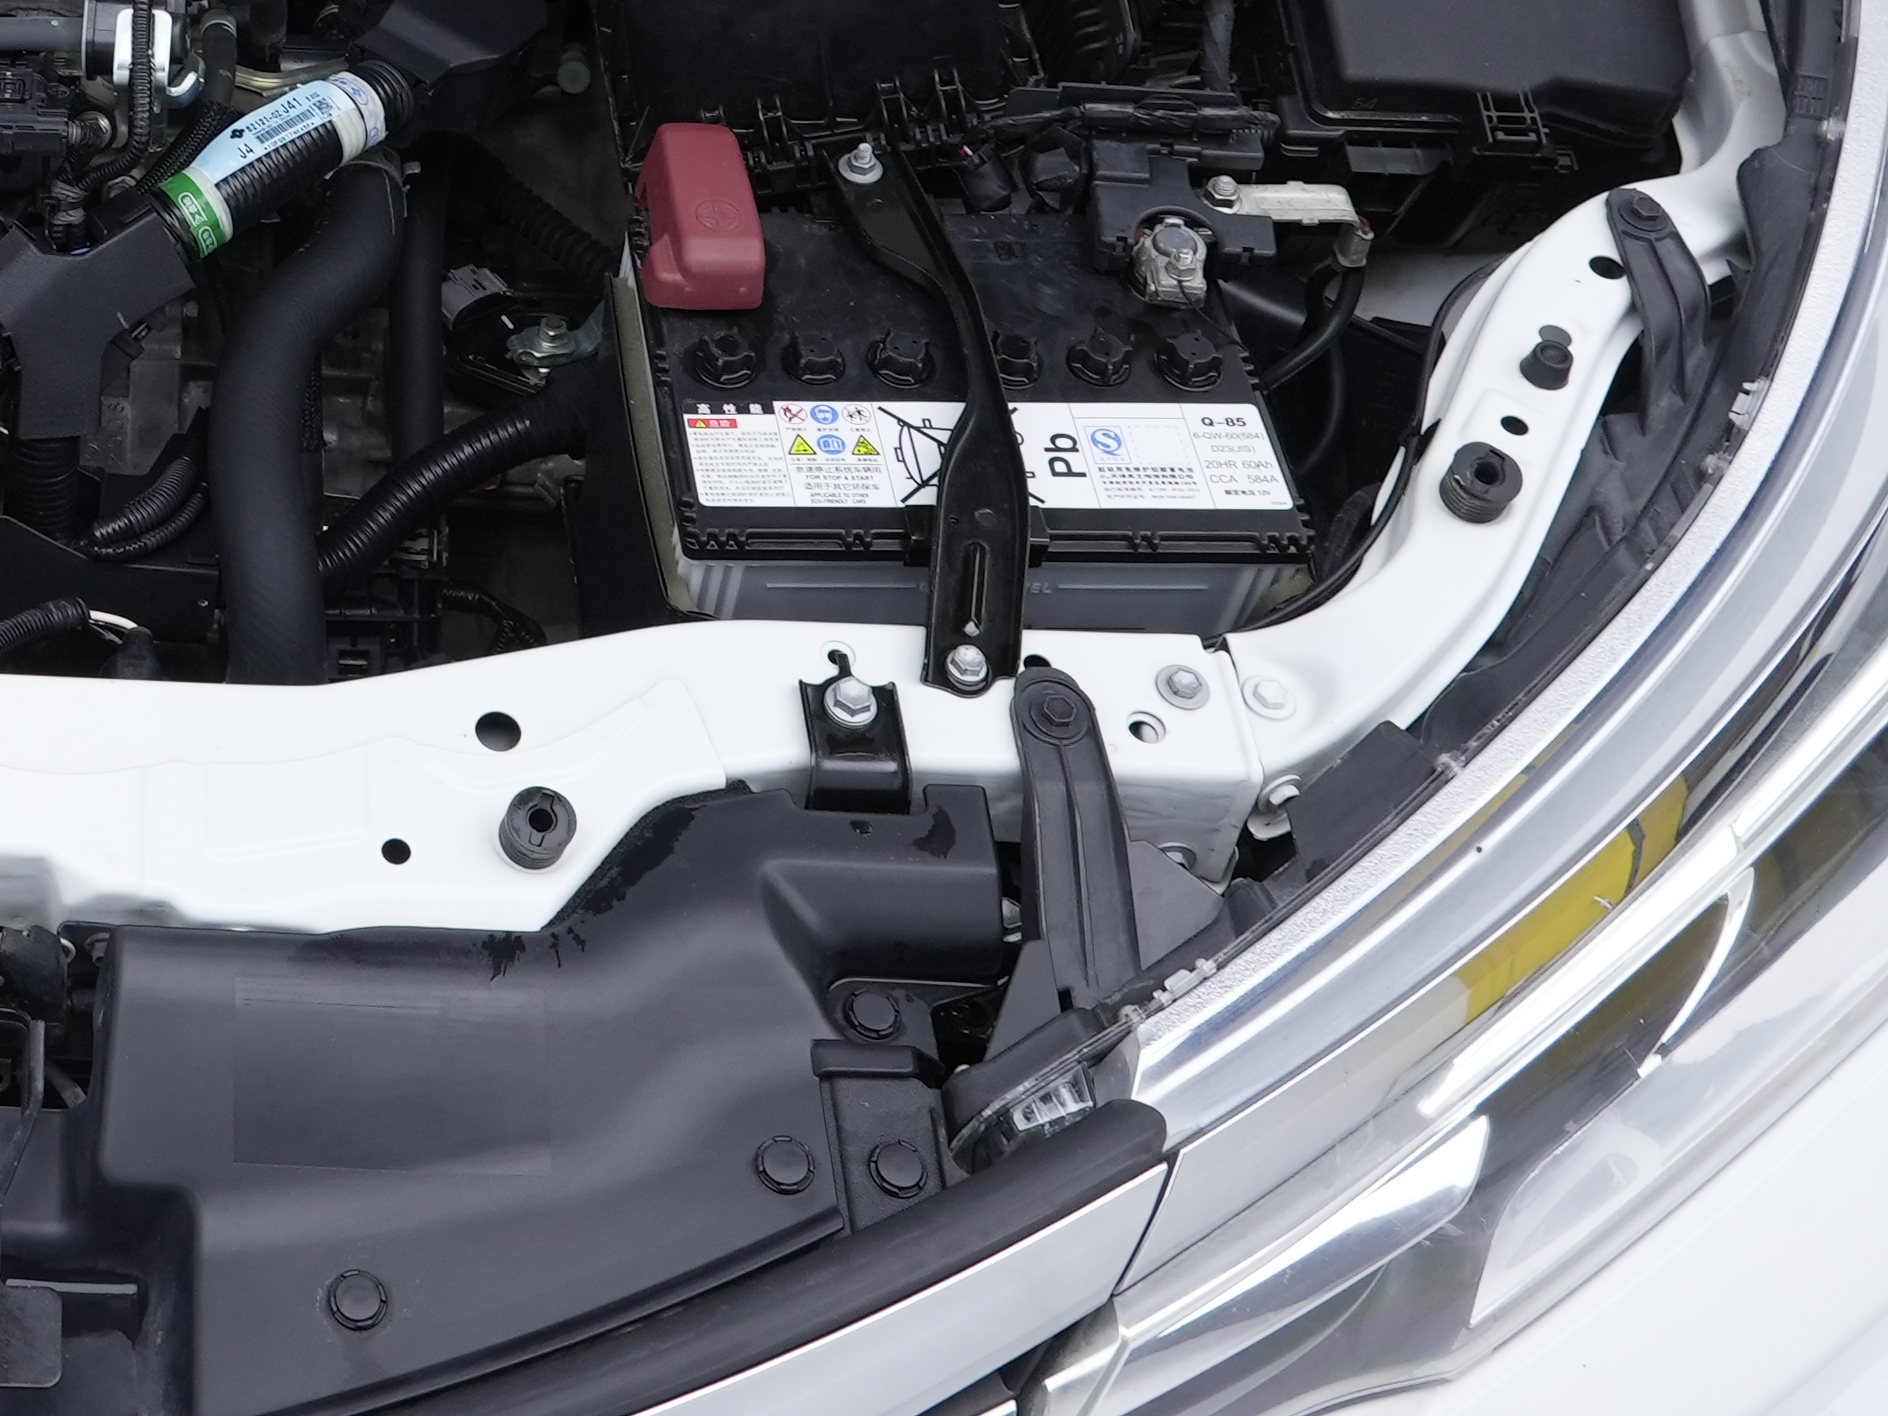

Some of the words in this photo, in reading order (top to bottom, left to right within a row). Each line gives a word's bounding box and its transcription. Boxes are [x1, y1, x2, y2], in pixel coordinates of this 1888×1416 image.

[237, 143, 255, 159] J4
[1043, 433, 1087, 478] Pb
[1204, 459, 1238, 470] 20HR
[1209, 474, 1239, 484] CCA
[1247, 474, 1280, 484] 584A
